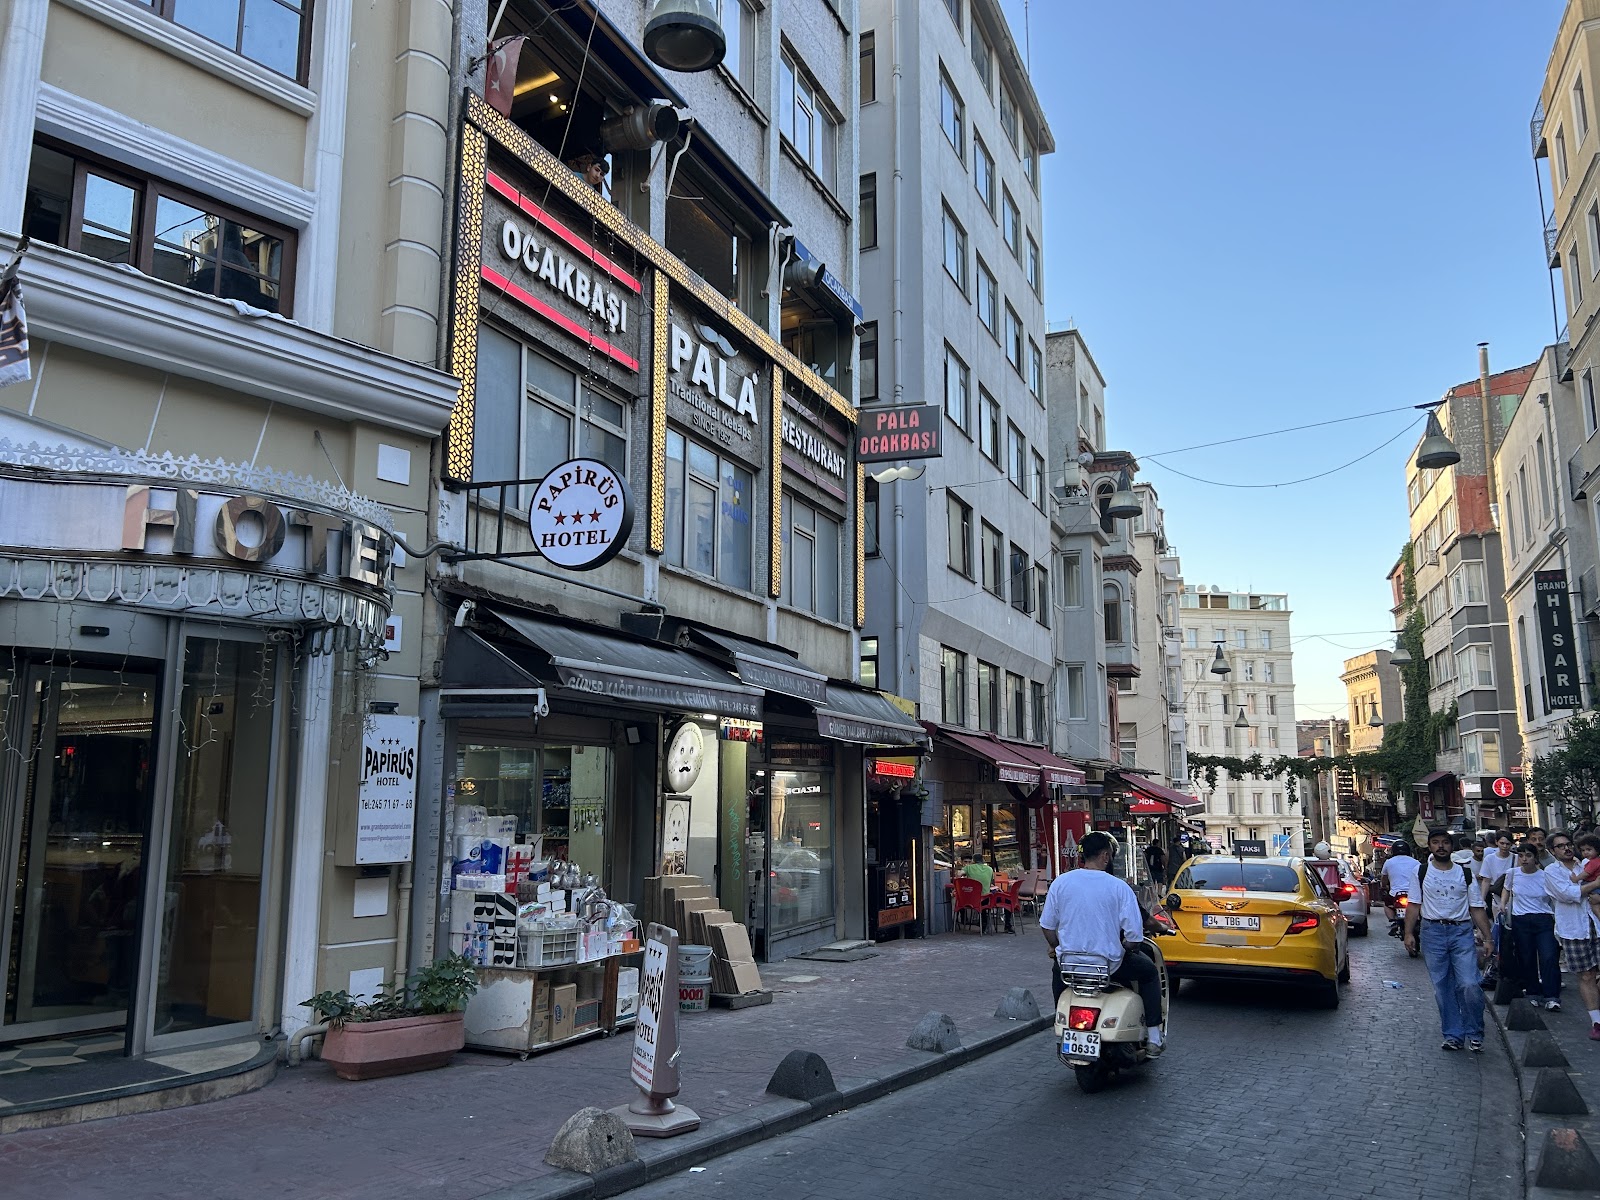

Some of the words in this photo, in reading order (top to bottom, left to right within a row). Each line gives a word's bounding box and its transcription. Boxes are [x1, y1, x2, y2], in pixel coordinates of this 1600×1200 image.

[502, 219, 627, 334] OCAKBAŞI
[669, 323, 759, 426] PALA
[670, 379, 720, 421] Traditional
[721, 410, 752, 441] Kebaps
[877, 410, 919, 431] PALA
[693, 412, 715, 436] SINCE
[781, 418, 846, 480] RESTAURANT
[860, 431, 936, 455] OCAKBAŞI
[538, 465, 618, 513] PAPİRÜS
[540, 529, 611, 548] HOTEL
[1537, 581, 1567, 591] GRAND
[1550, 695, 1580, 706] HOTEL
[364, 745, 414, 780] PAPİRÜS
[376, 777, 399, 787] HOTEL
[384, 799, 391, 810] 71
[1208, 916, 1218, 925] 34
[1225, 917, 1240, 926] TBG
[1248, 918, 1258, 927] 04
[1065, 1032, 1077, 1042] 34
[1086, 1034, 1099, 1045] GZ
[1071, 1043, 1096, 1055] 0633
